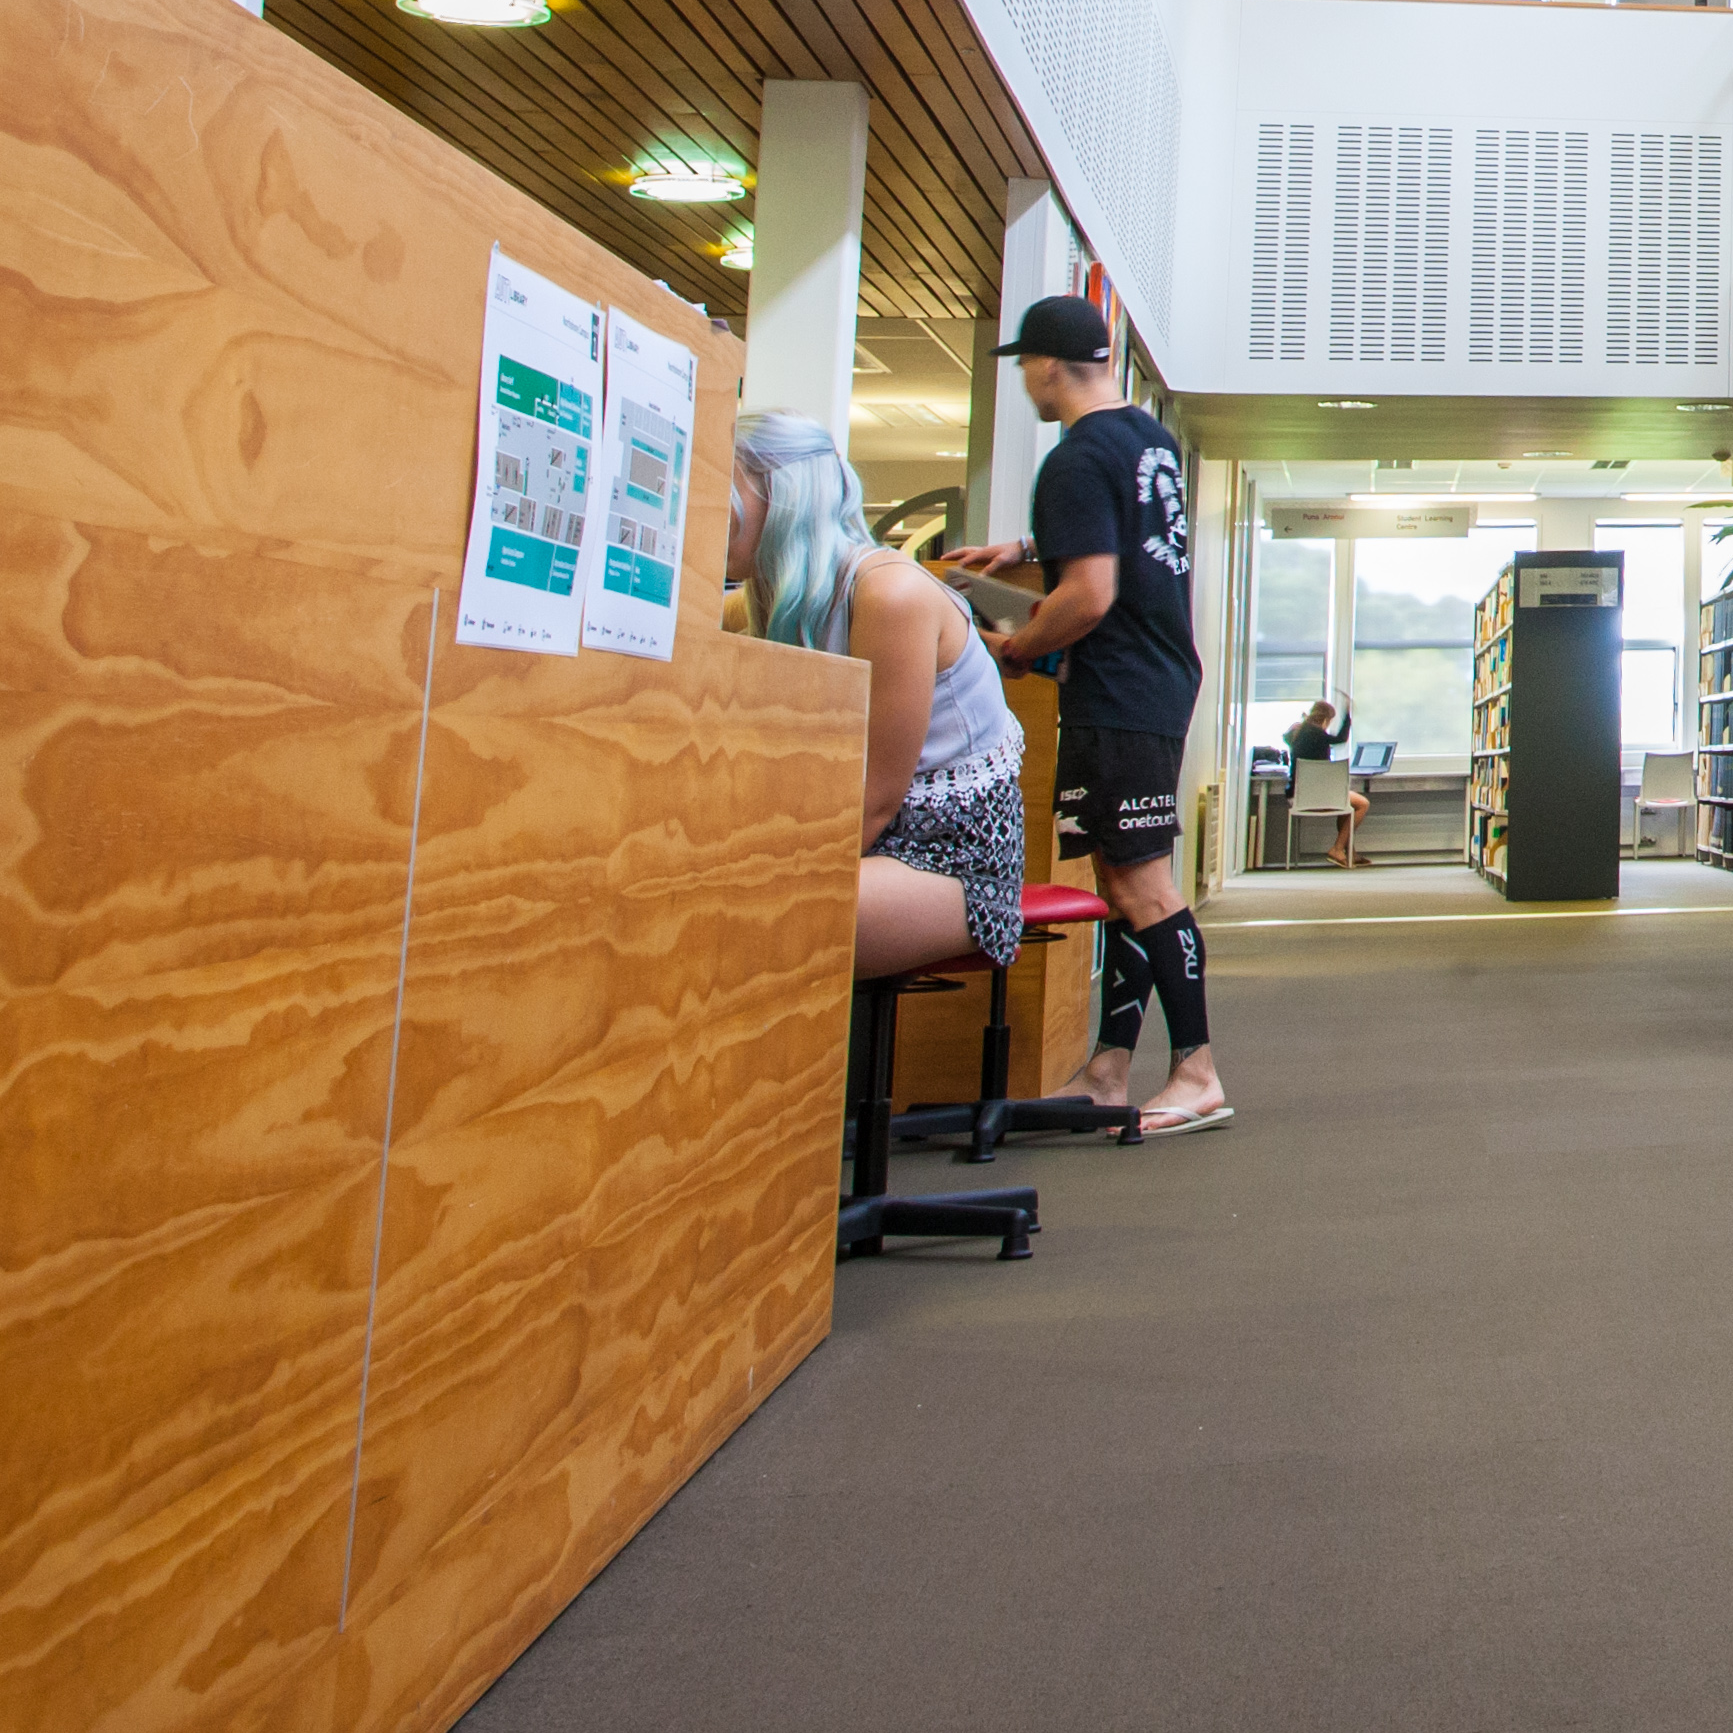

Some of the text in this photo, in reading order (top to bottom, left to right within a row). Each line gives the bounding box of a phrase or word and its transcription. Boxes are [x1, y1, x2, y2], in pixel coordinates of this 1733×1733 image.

[1396, 514, 1454, 523] Student Learning
[1118, 794, 1176, 812] ALCATEL
[1118, 811, 1177, 830] onetouch
